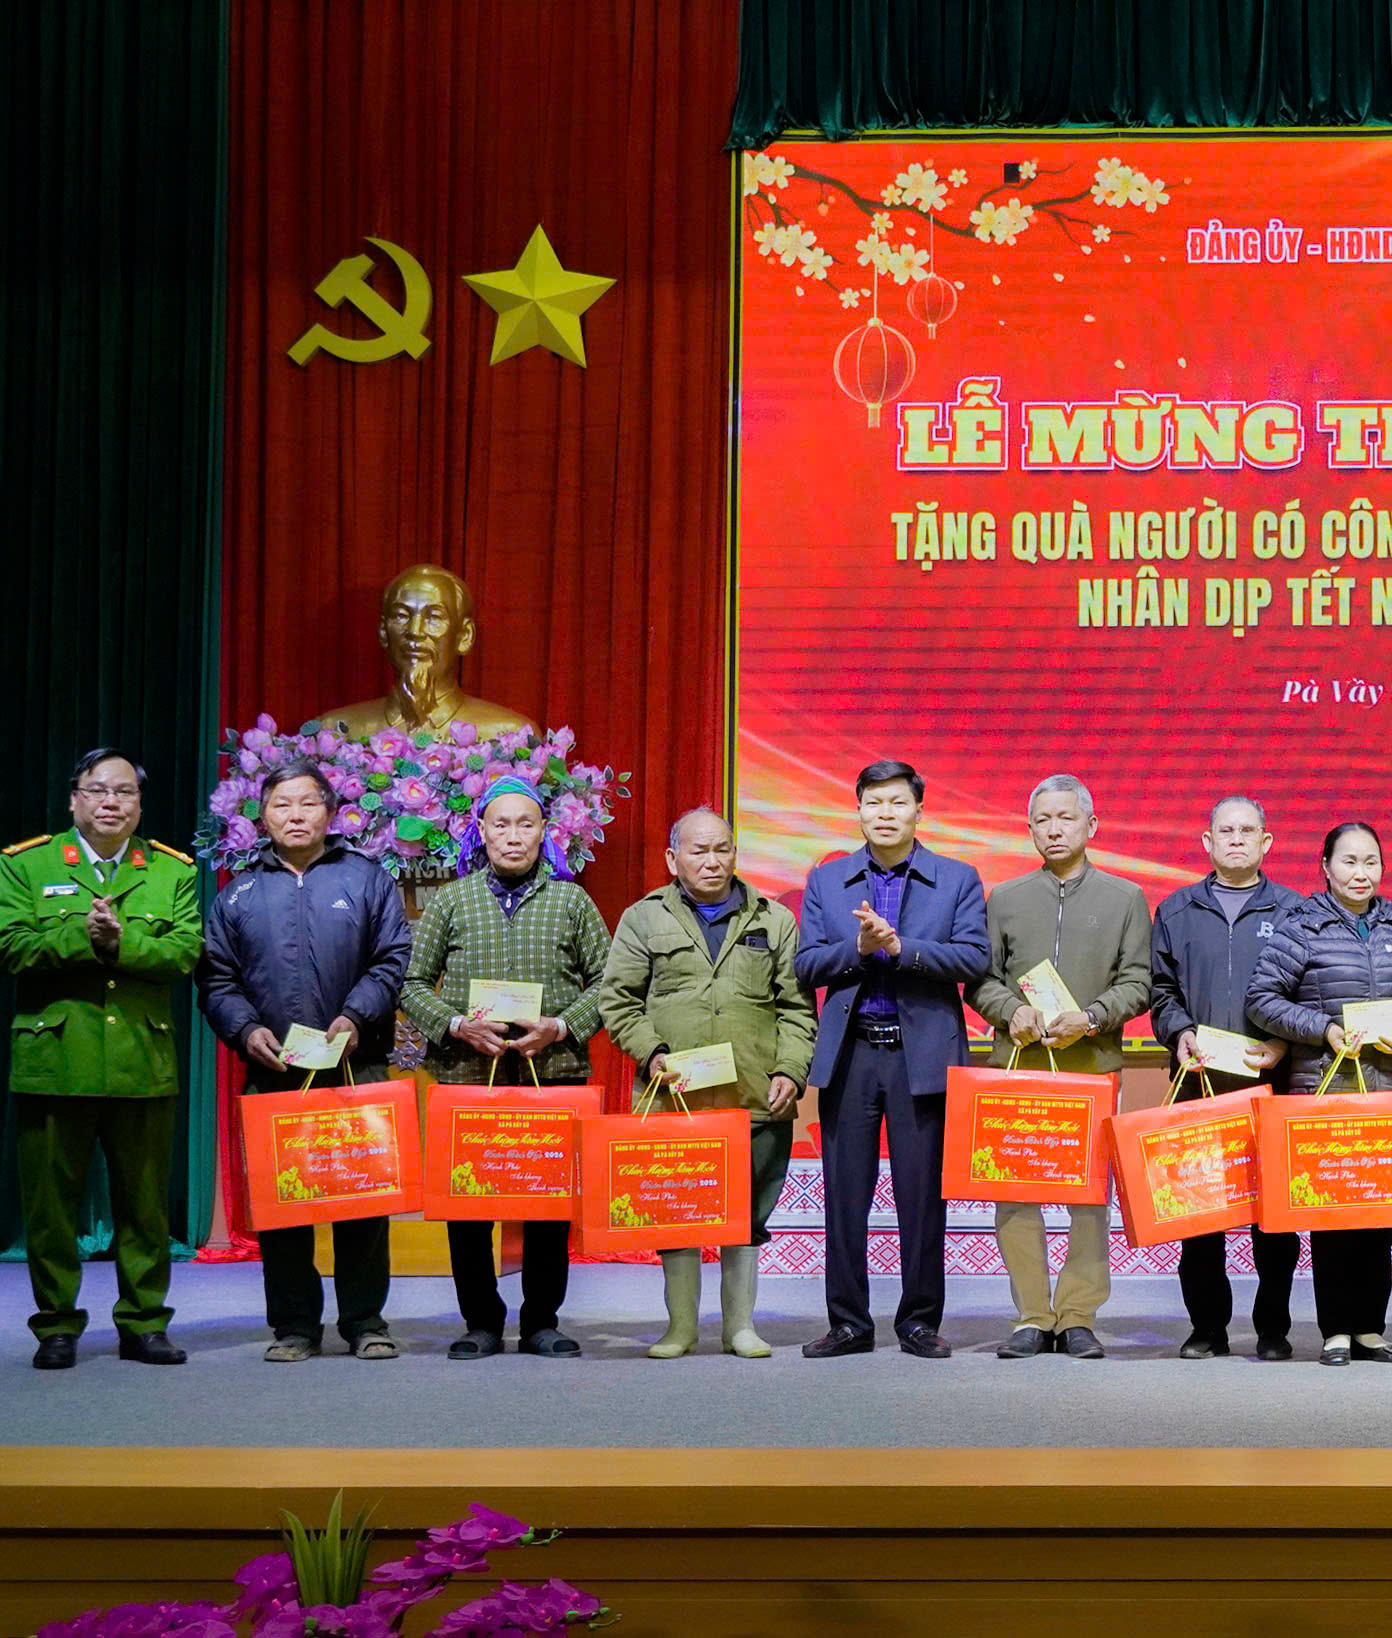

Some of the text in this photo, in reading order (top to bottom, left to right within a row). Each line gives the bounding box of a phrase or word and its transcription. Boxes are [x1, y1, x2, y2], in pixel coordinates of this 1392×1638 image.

[1187, 219, 1260, 263] ĐẢNG
[1265, 218, 1303, 263] ỦY
[898, 376, 1008, 470] LỄ
[1021, 389, 1304, 470] MỪNG
[891, 501, 997, 572] TẶNG
[1011, 500, 1094, 565] QUÀ
[1109, 497, 1237, 561] NGƯỜI
[1252, 496, 1306, 560] CÓ
[1078, 566, 1189, 627] NHÂN
[1204, 578, 1272, 637] DỊP
[1287, 566, 1356, 627] TẾT
[1282, 679, 1320, 703] Pà
[1331, 678, 1384, 707] Vầy
